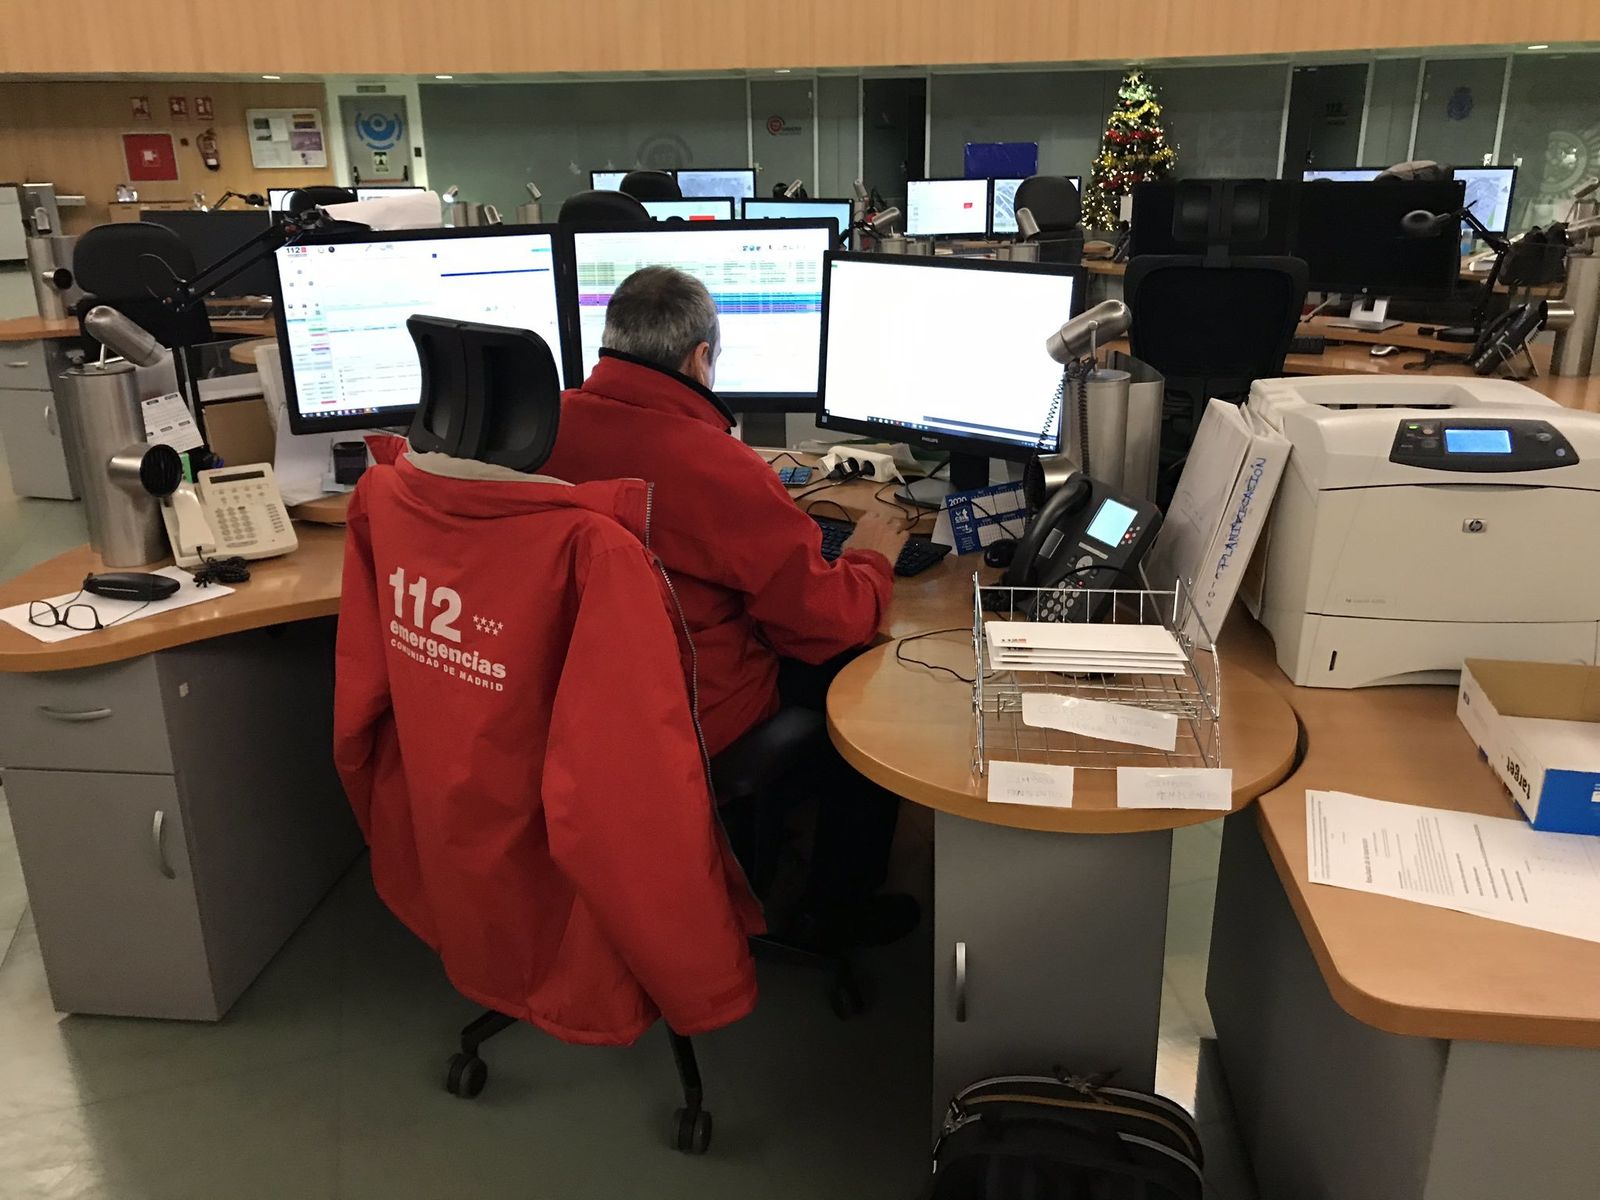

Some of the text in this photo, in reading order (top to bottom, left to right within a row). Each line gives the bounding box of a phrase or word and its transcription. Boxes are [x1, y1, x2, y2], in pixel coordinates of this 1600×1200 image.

[286, 246, 301, 254] 112
[389, 566, 462, 643] 112
[390, 620, 507, 679] emergencias
[390, 638, 504, 692] COMUNIDAD DE MADRID
[1506, 756, 1532, 801] target
